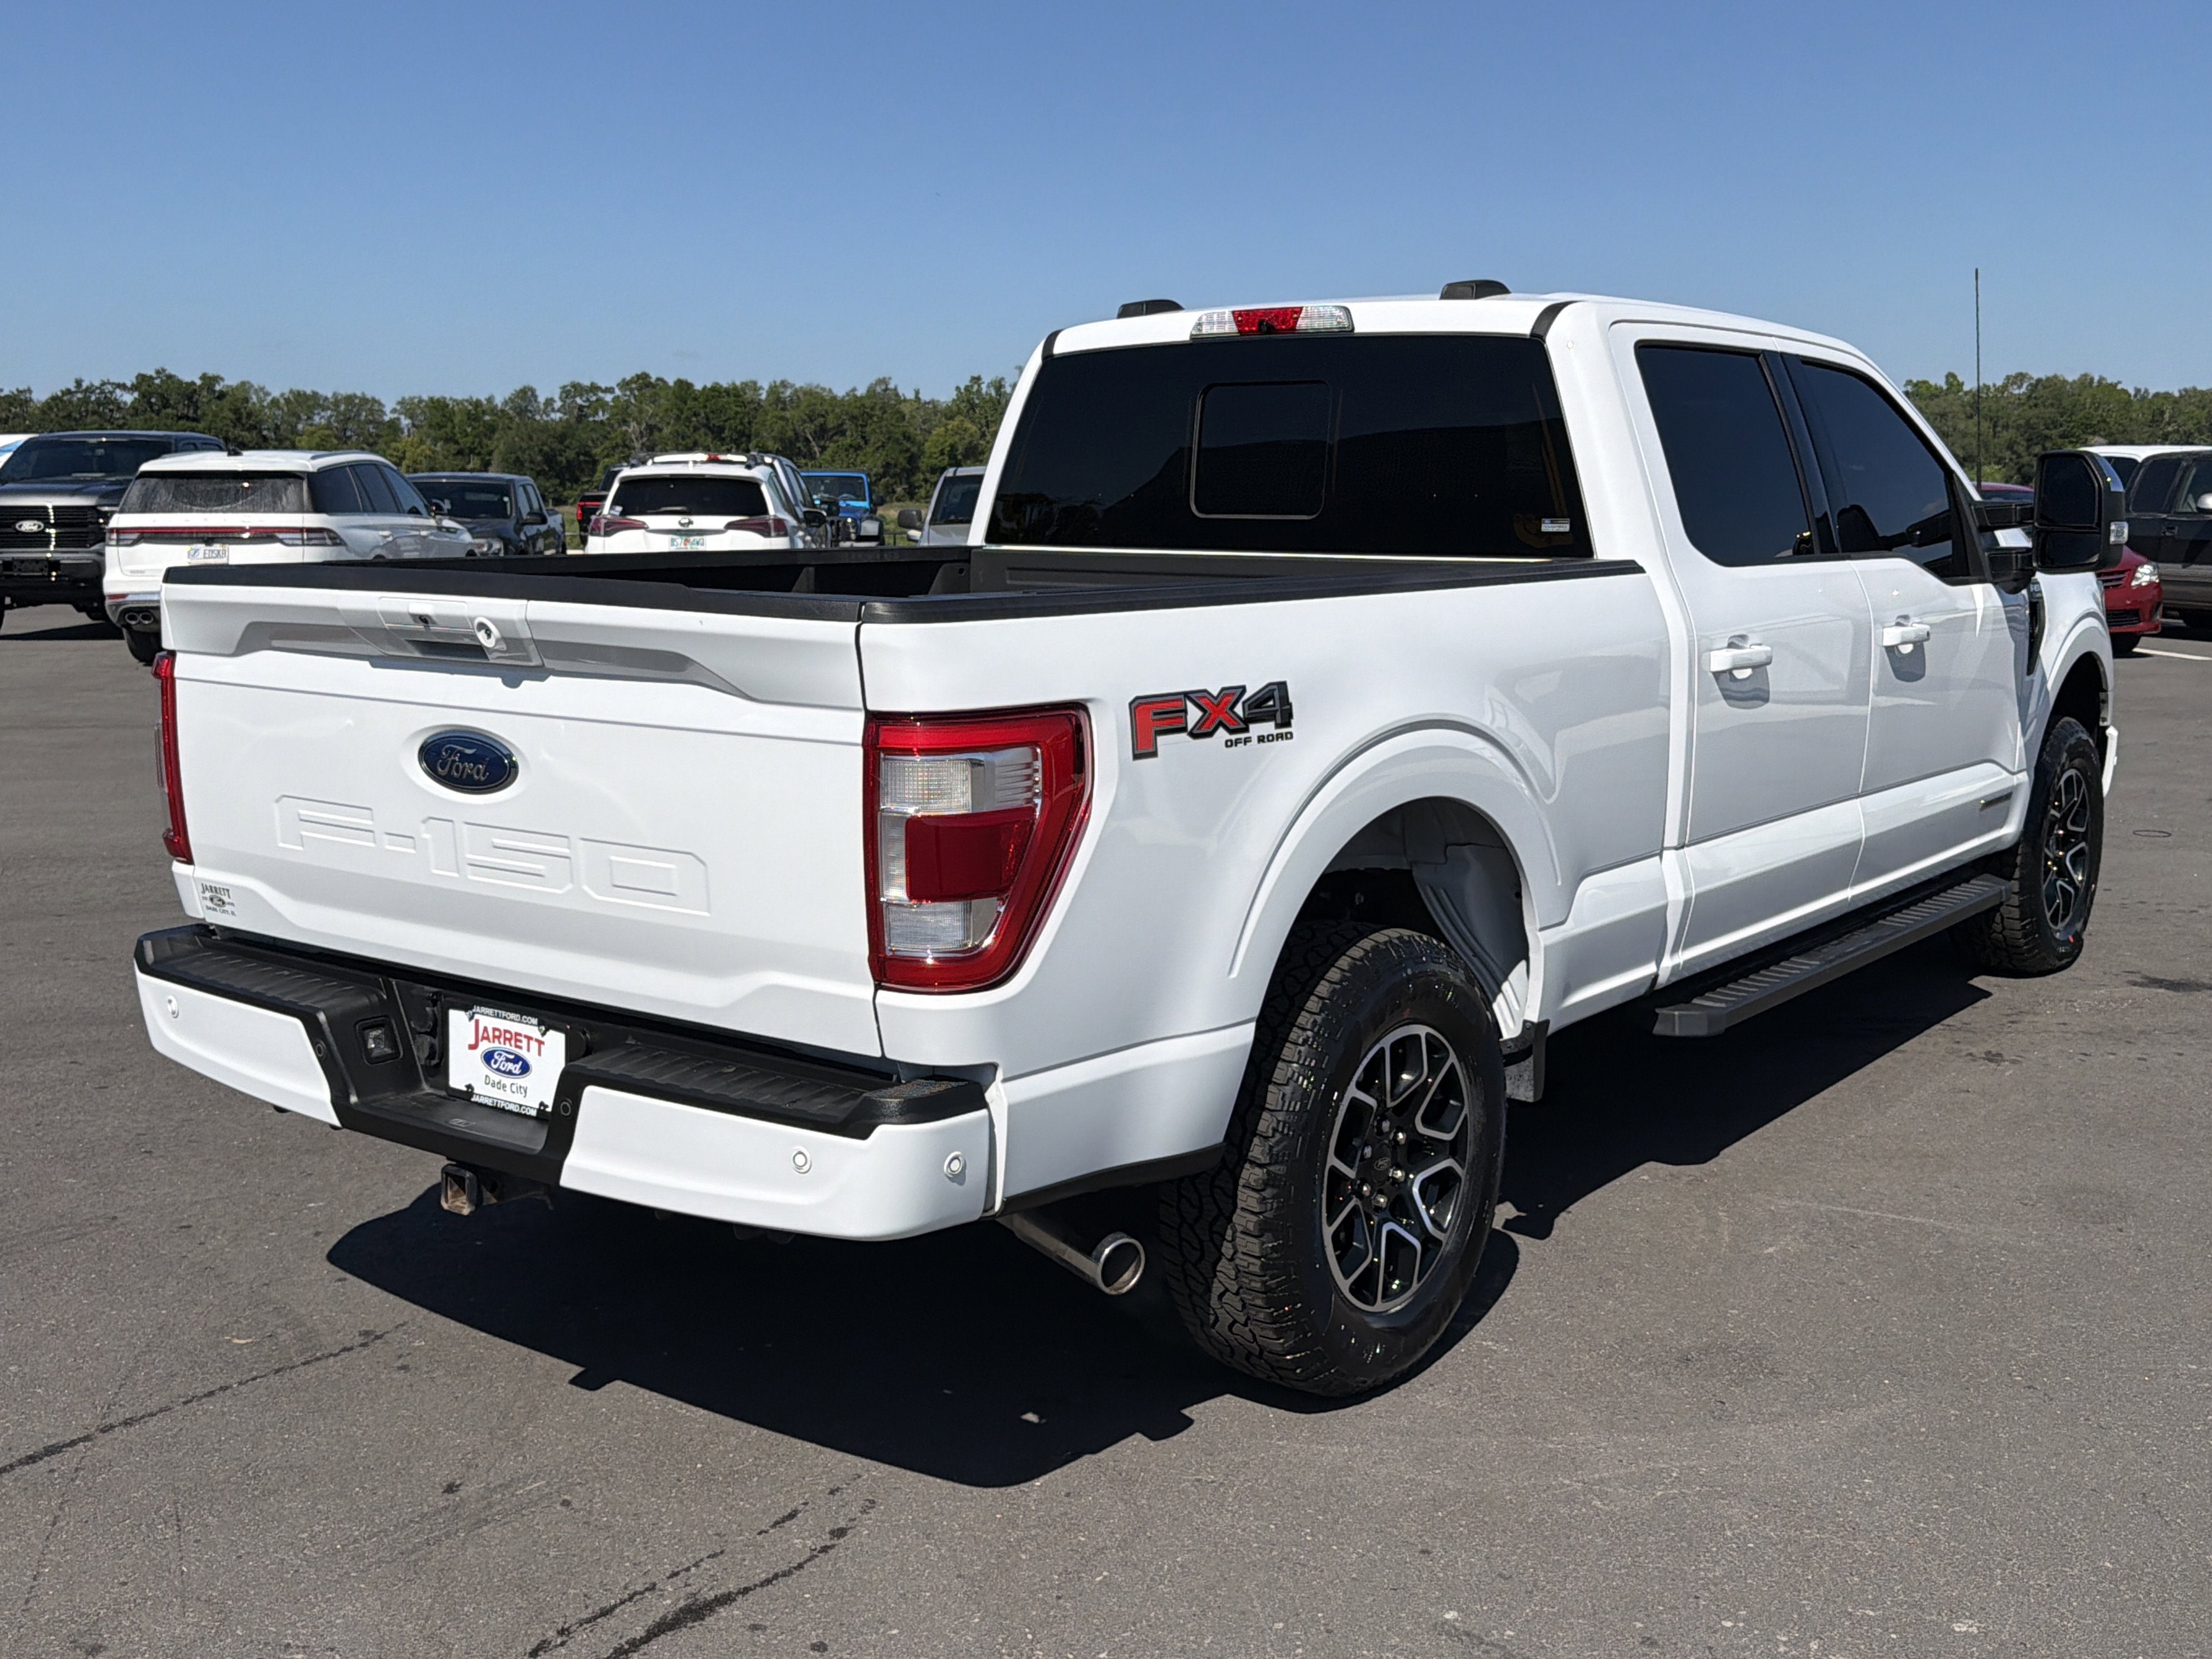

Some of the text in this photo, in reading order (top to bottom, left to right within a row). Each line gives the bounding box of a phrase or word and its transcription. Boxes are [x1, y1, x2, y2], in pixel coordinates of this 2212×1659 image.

[1128, 680, 1293, 761] FX4
[1224, 731, 1294, 748] OFF ROAD
[436, 743, 490, 781] Ford
[274, 794, 710, 917] F-150
[472, 1005, 539, 1025] JARRETTFORD.COM
[468, 1019, 545, 1057] JARRETT
[490, 1051, 523, 1075] Ford
[484, 1074, 528, 1099] Dade City
[471, 1094, 537, 1117] JARRETTFORD.COM
